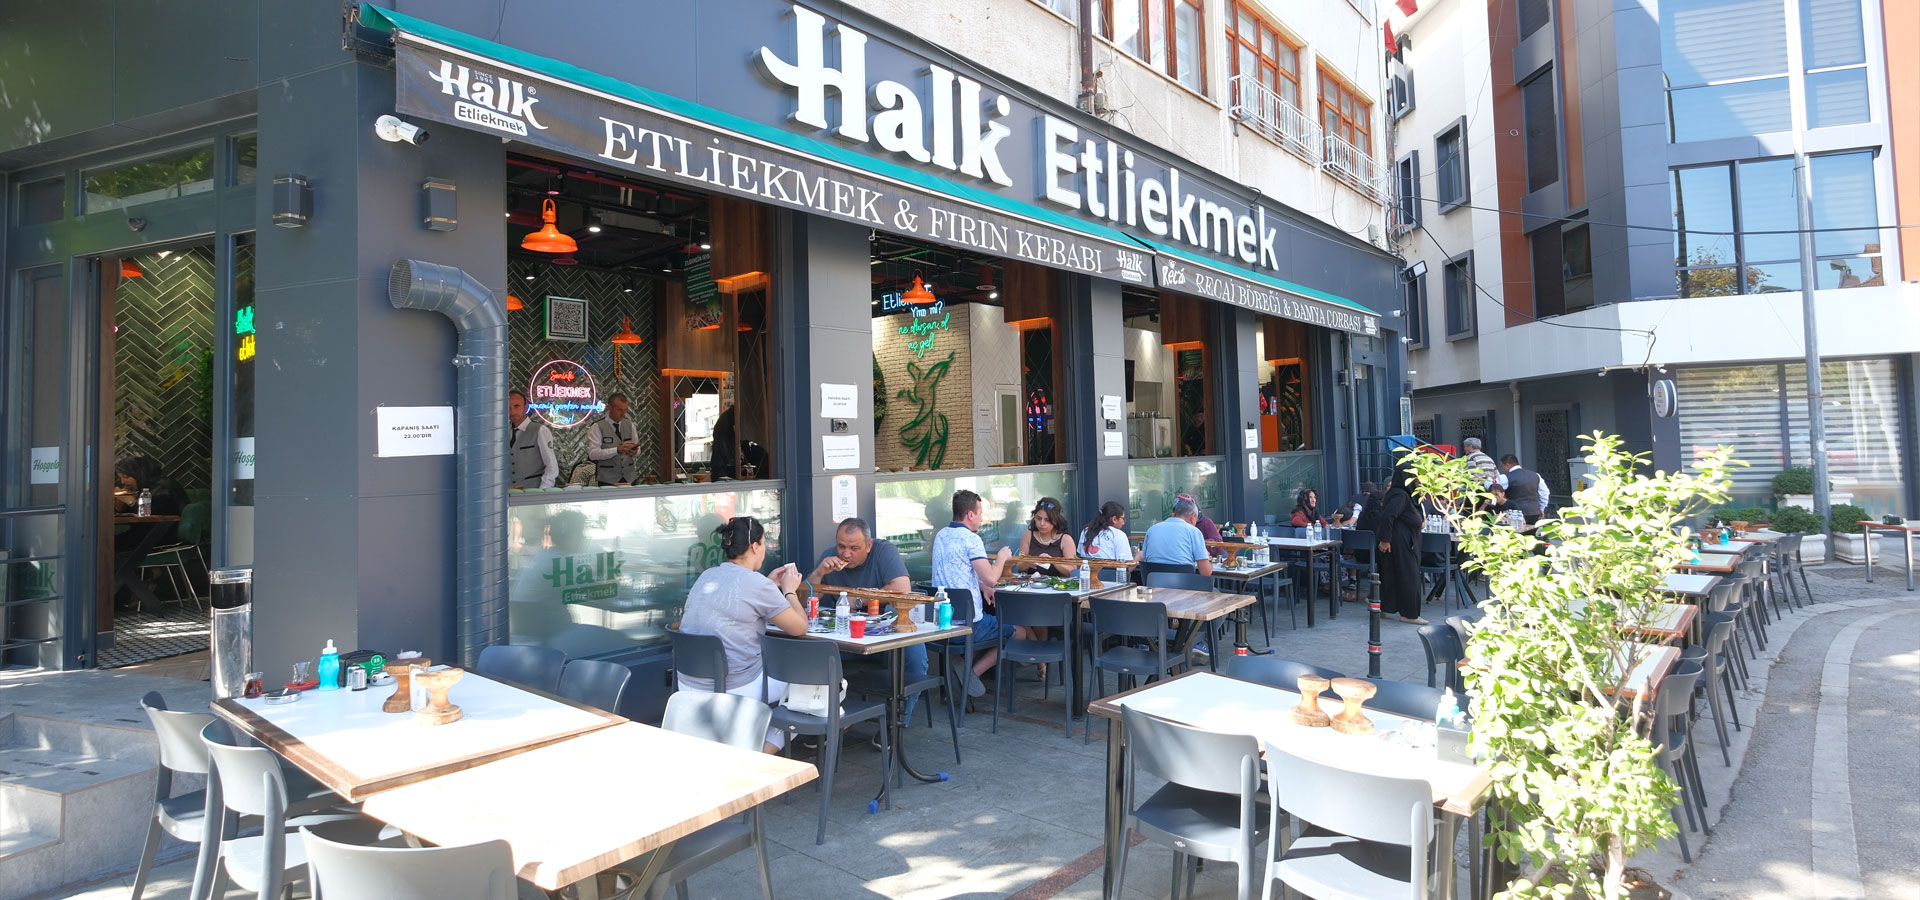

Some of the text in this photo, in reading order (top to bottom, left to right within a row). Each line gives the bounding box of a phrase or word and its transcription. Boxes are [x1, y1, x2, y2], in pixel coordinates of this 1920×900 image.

[428, 60, 548, 130] Halk
[458, 105, 524, 133] Etliekmek
[760, 5, 1279, 272] Halk Etliekmek
[599, 116, 1103, 274] ETLİEKMEK & FIRIN KEBABI
[1116, 249, 1147, 276] Halk
[1283, 298, 1292, 317] &
[1293, 301, 1326, 326] BAMYA
[542, 551, 626, 588] Halk
